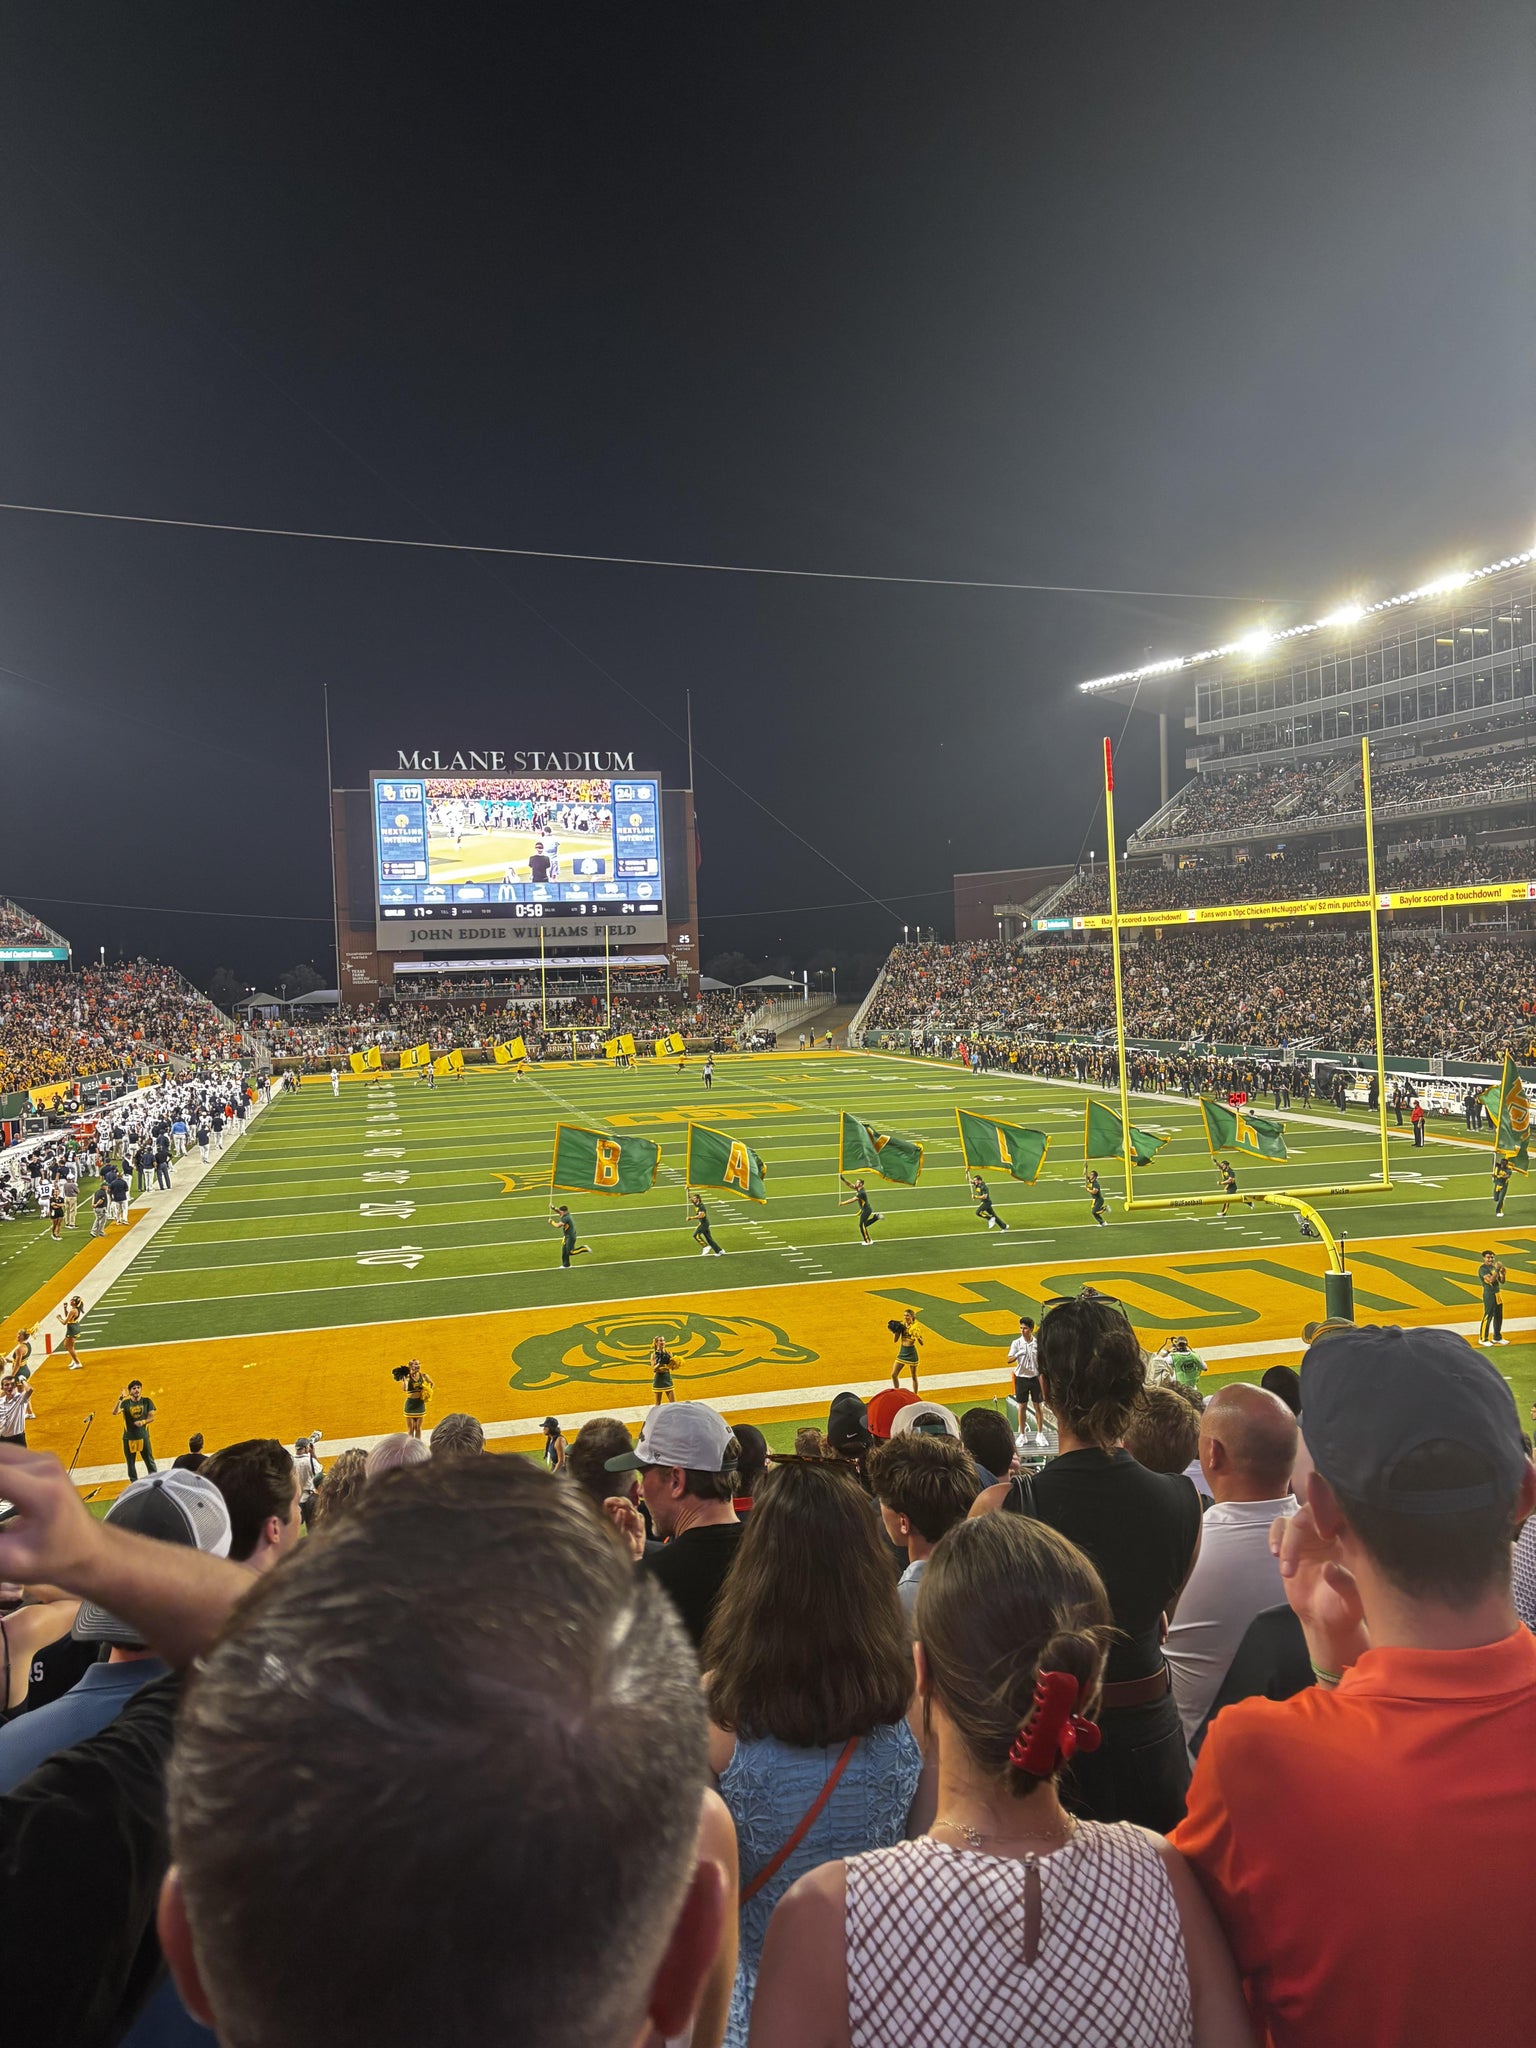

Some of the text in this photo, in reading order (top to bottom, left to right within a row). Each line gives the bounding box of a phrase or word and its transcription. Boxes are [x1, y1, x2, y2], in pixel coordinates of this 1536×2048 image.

[397, 750, 636, 771] McLANE STADIUM
[383, 836, 422, 844] INTERNET
[1399, 895, 1422, 907] Baylor
[1423, 893, 1449, 903] scored
[1455, 889, 1502, 901] touchdown!
[414, 907, 425, 917] 17
[451, 907, 458, 917] 3
[515, 903, 543, 918] 0:58
[580, 904, 587, 914] 3
[591, 904, 598, 914] 3
[621, 903, 635, 914] 24
[1201, 911, 1215, 919] Fans
[1246, 906, 1271, 916] Chicken
[1318, 903, 1327, 911] $2
[1327, 901, 1341, 910] min.
[1101, 918, 1120, 926] Bayr
[1121, 916, 1142, 924] scored
[1148, 914, 1182, 923] touchdown!
[410, 925, 637, 943] JOHN EDDIE WILLIAMS FIELD
[679, 934, 690, 944] 25
[594, 1138, 621, 1187] B
[723, 1140, 749, 1191] A
[40, 1185, 50, 1194] 18
[359, 1200, 417, 1217] 20
[356, 1245, 425, 1265] 10
